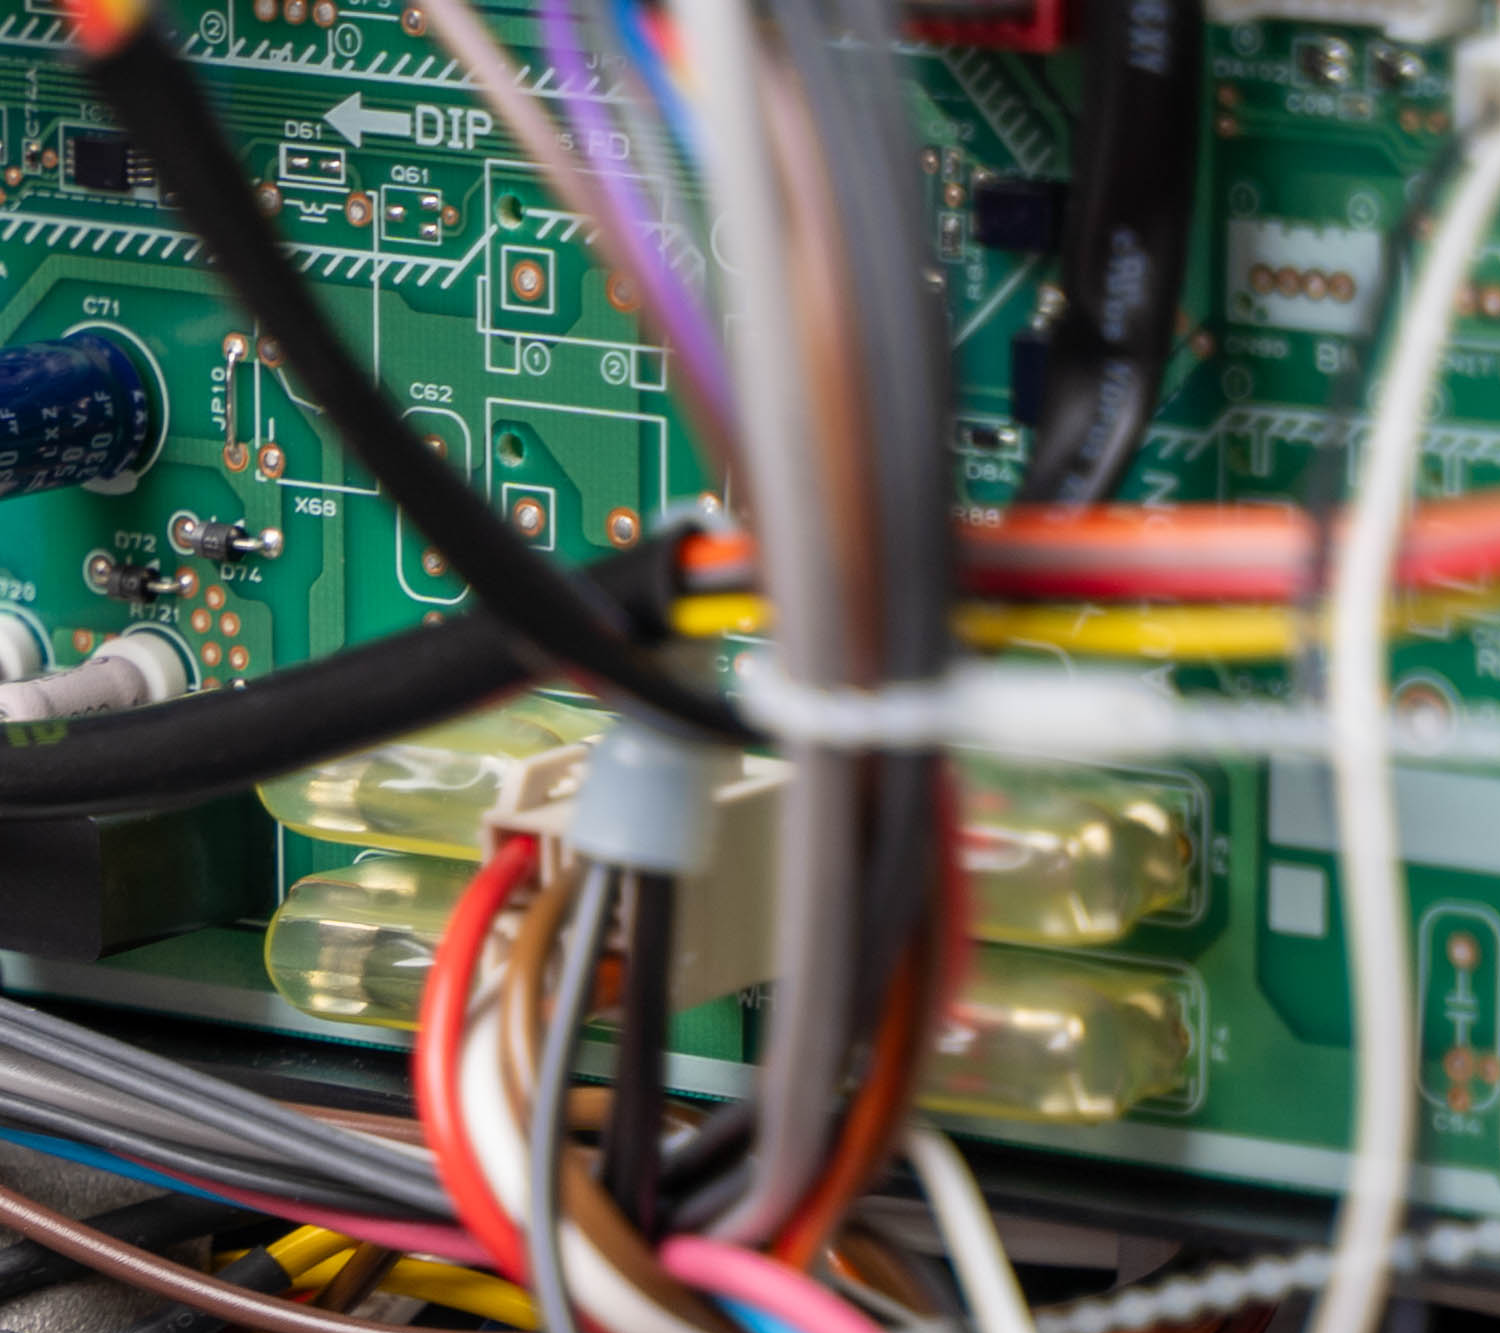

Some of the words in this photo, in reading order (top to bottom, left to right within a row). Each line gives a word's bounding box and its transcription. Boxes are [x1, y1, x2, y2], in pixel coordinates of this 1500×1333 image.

[284, 119, 323, 140] D61
[414, 103, 493, 150] DIP
[390, 164, 430, 184] Q61
[82, 296, 121, 317] C71
[211, 368, 227, 432] JP10
[409, 381, 453, 403] C62
[294, 496, 337, 517] X68
[114, 531, 157, 553] D72
[219, 563, 263, 583] D74
